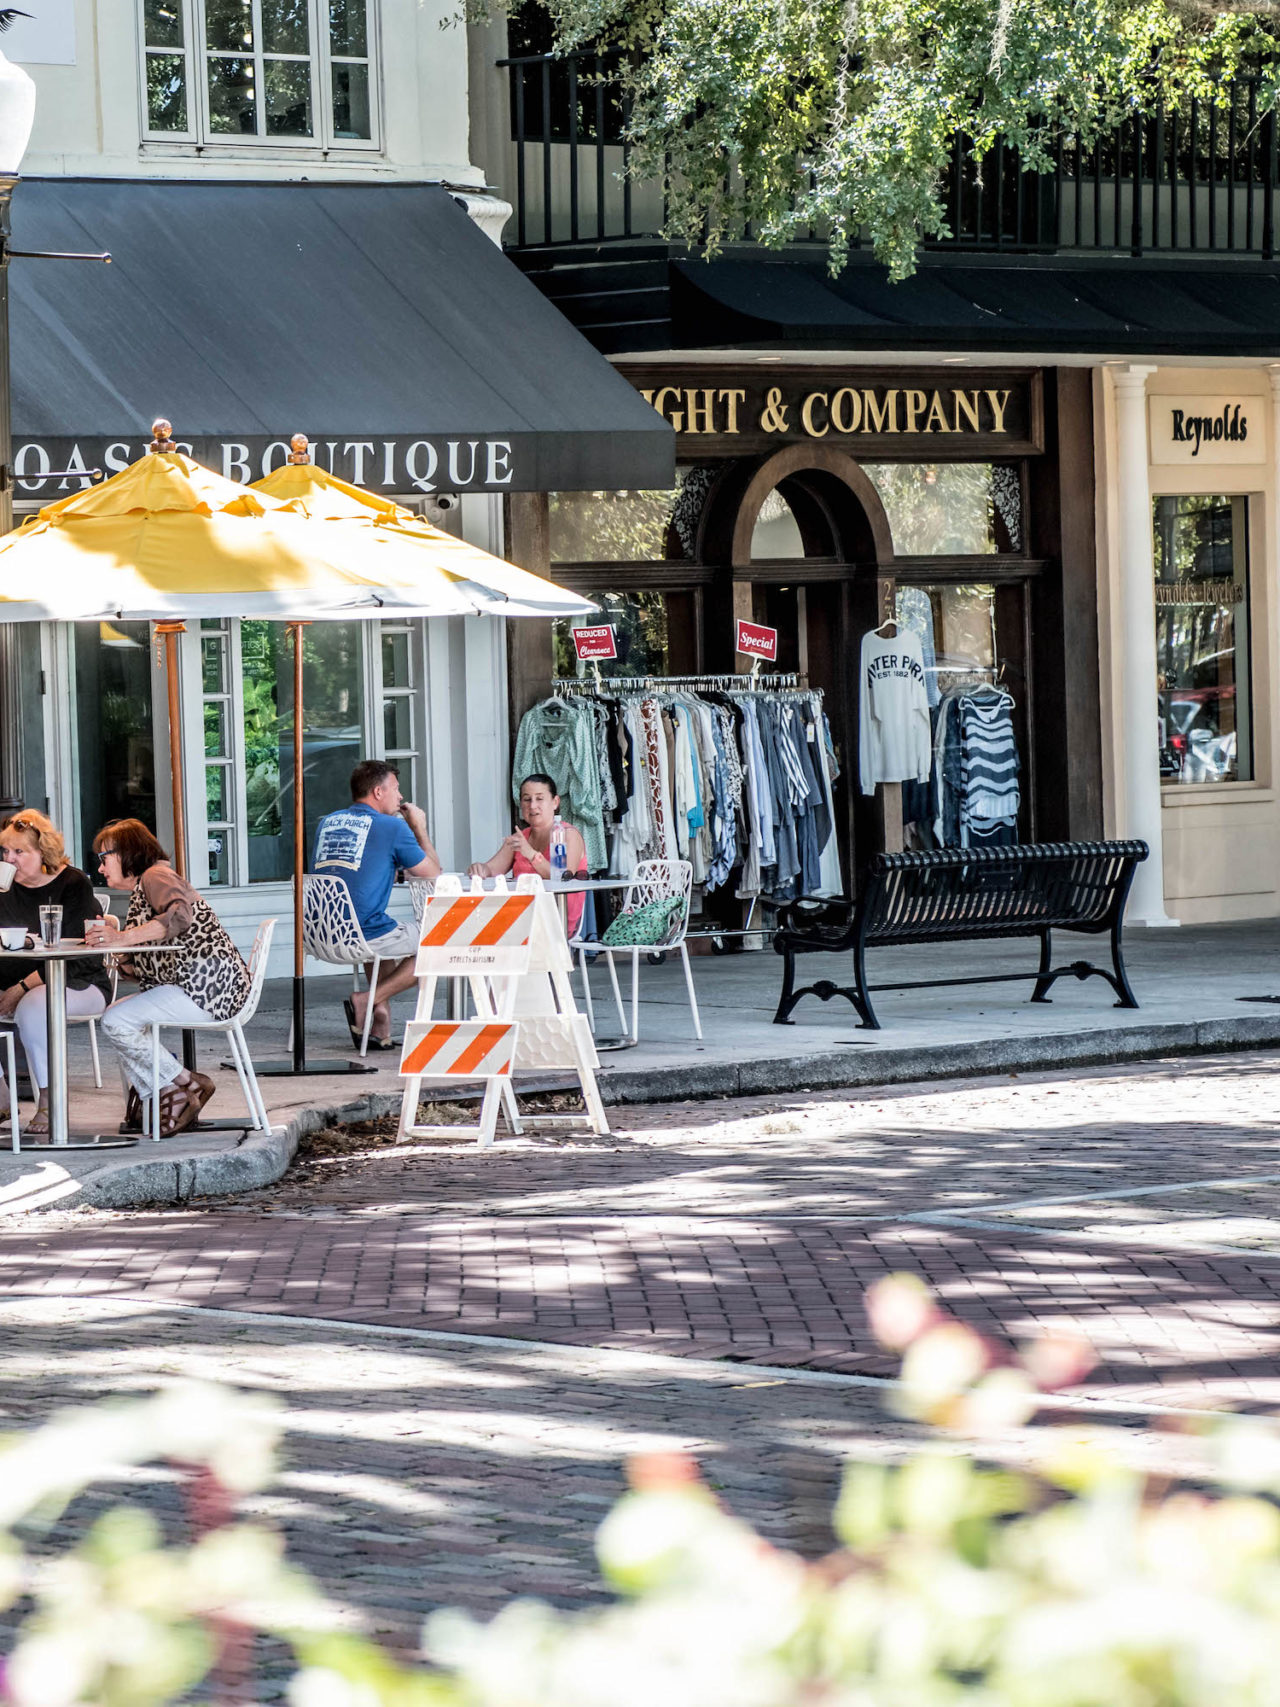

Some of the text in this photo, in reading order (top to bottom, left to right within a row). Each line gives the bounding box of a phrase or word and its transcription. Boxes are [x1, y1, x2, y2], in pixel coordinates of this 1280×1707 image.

[640, 386, 1012, 438] GHT & COMPANY
[1171, 404, 1247, 456] Reynolds
[14, 440, 514, 492] OAS BOUTIQUE
[575, 629, 607, 638] REDUCED
[740, 632, 773, 650] Special
[877, 670, 891, 680] EST
